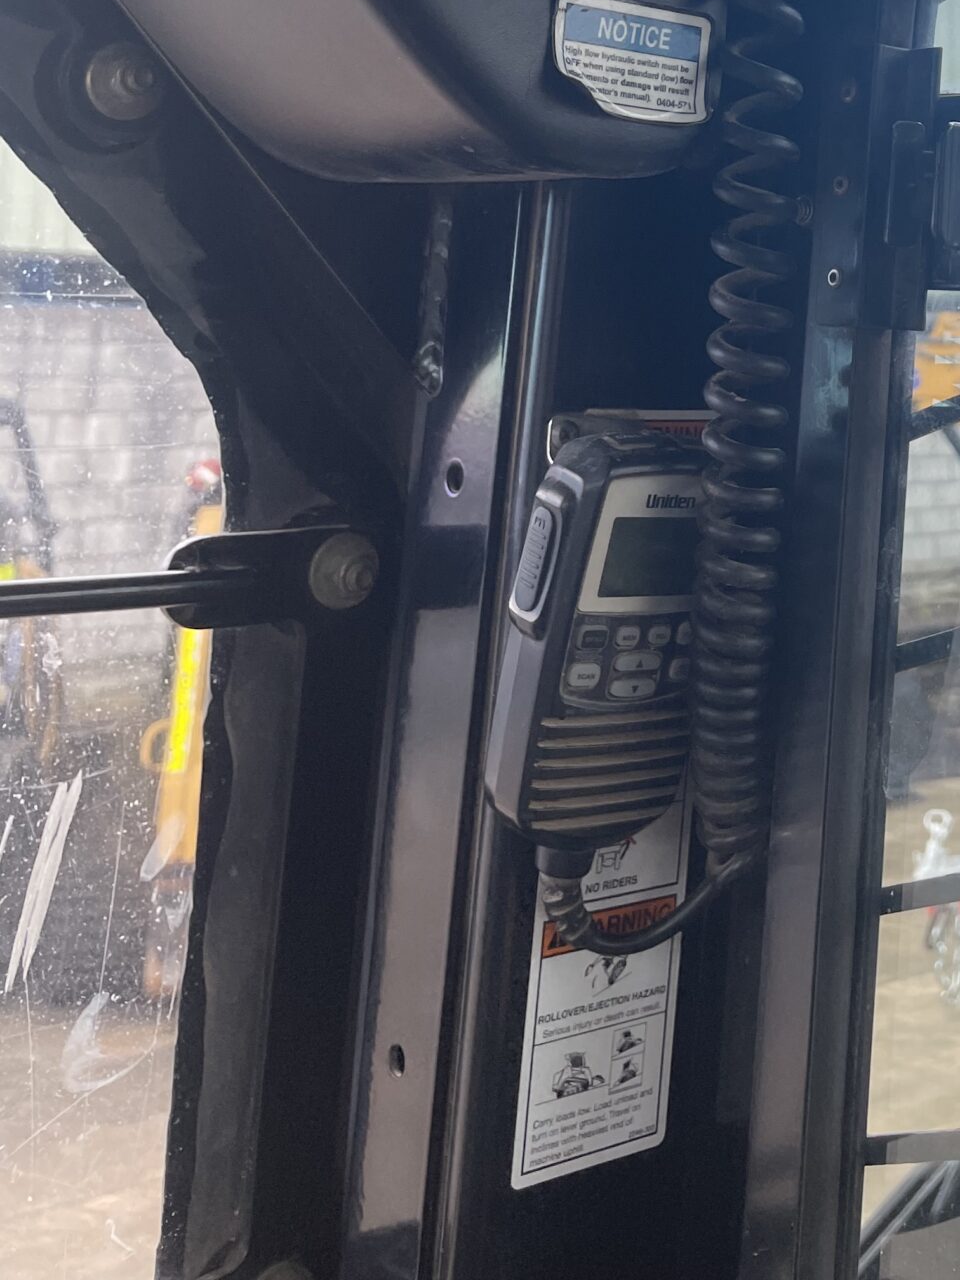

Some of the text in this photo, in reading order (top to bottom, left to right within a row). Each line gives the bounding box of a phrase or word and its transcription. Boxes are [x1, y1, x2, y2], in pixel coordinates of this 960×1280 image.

[598, 16, 673, 50] NOTICE
[565, 45, 583, 58] High
[602, 50, 635, 66] hydraulic
[637, 57, 660, 69] switch
[680, 64, 690, 73] be
[583, 60, 604, 71] when
[606, 64, 625, 76] using
[627, 67, 659, 81] standard
[679, 75, 694, 86] flow
[611, 77, 619, 85] or
[620, 77, 652, 92] damage
[653, 84, 667, 94] will
[668, 86, 690, 97] result
[646, 493, 697, 510] Uniden
[585, 875, 638, 895] NO RIDERS
[537, 984, 667, 1025] ROLLOVER/EJECTION HAZARD
